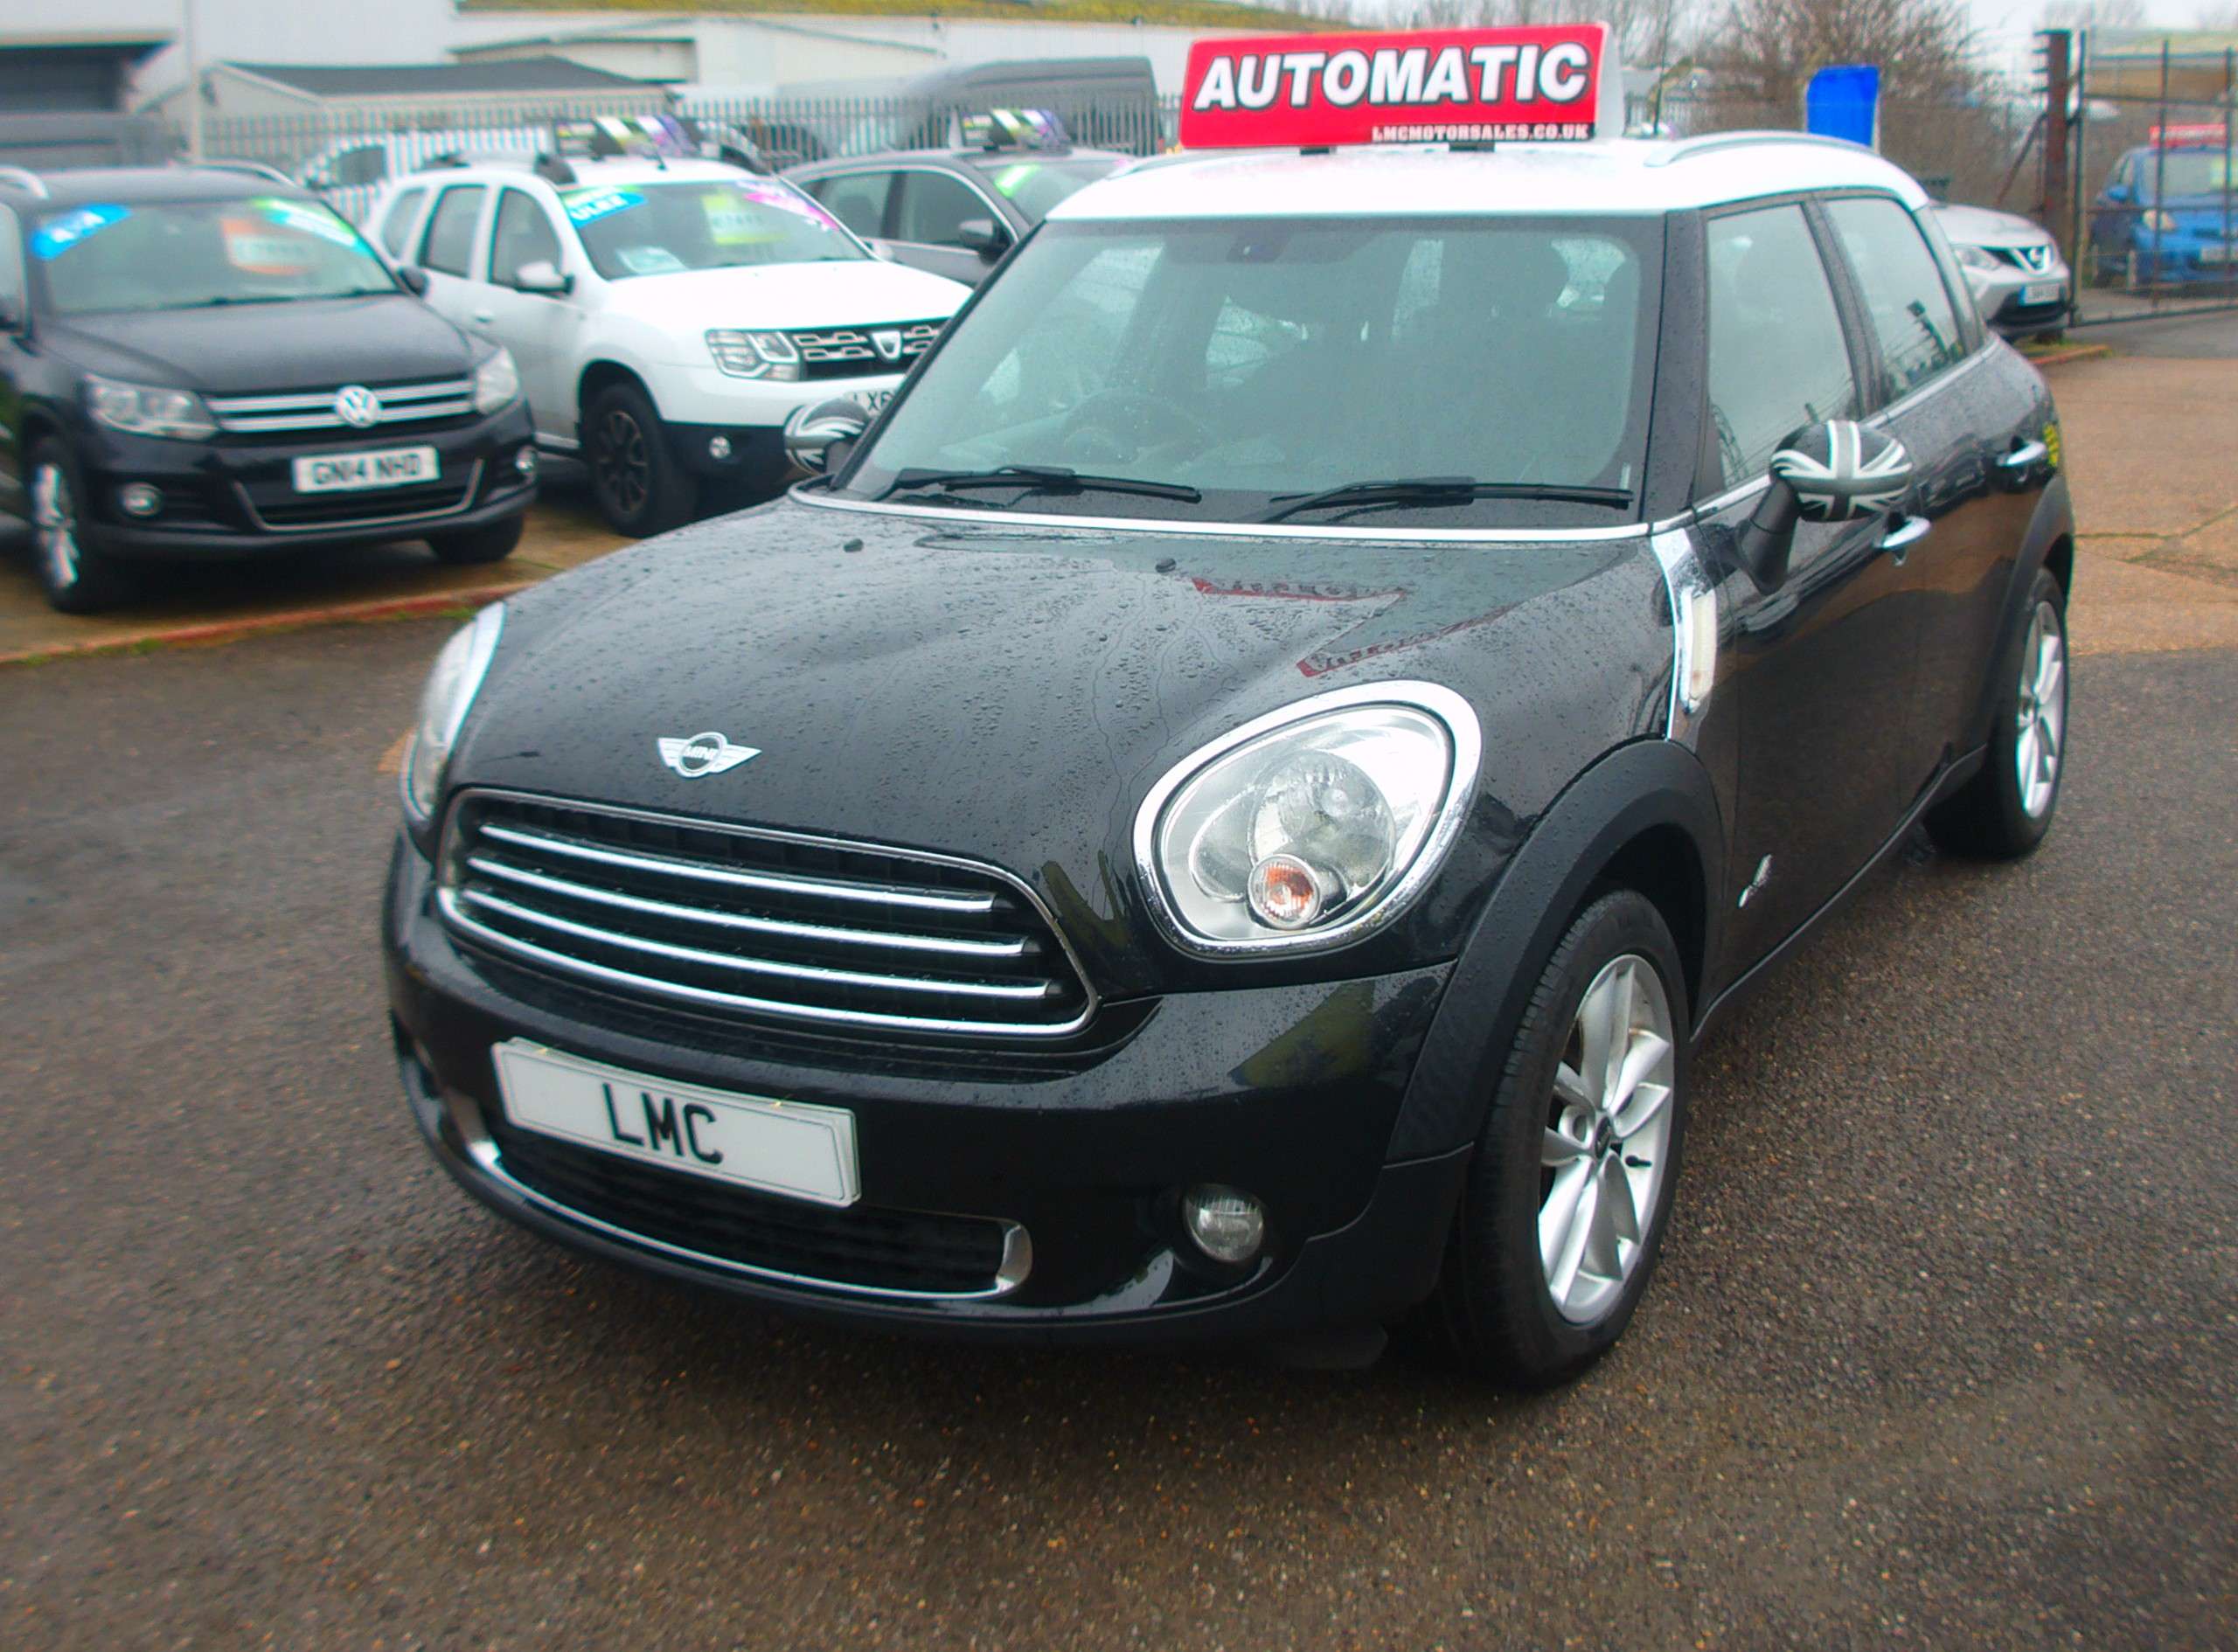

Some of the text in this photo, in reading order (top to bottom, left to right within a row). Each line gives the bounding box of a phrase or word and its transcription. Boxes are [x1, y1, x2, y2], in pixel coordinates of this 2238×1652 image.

[1192, 42, 1590, 111] AUTOMATIC
[1371, 122, 1589, 142] LMCMOTORSALES.CO.UK
[601, 1082, 724, 1164] LMC
